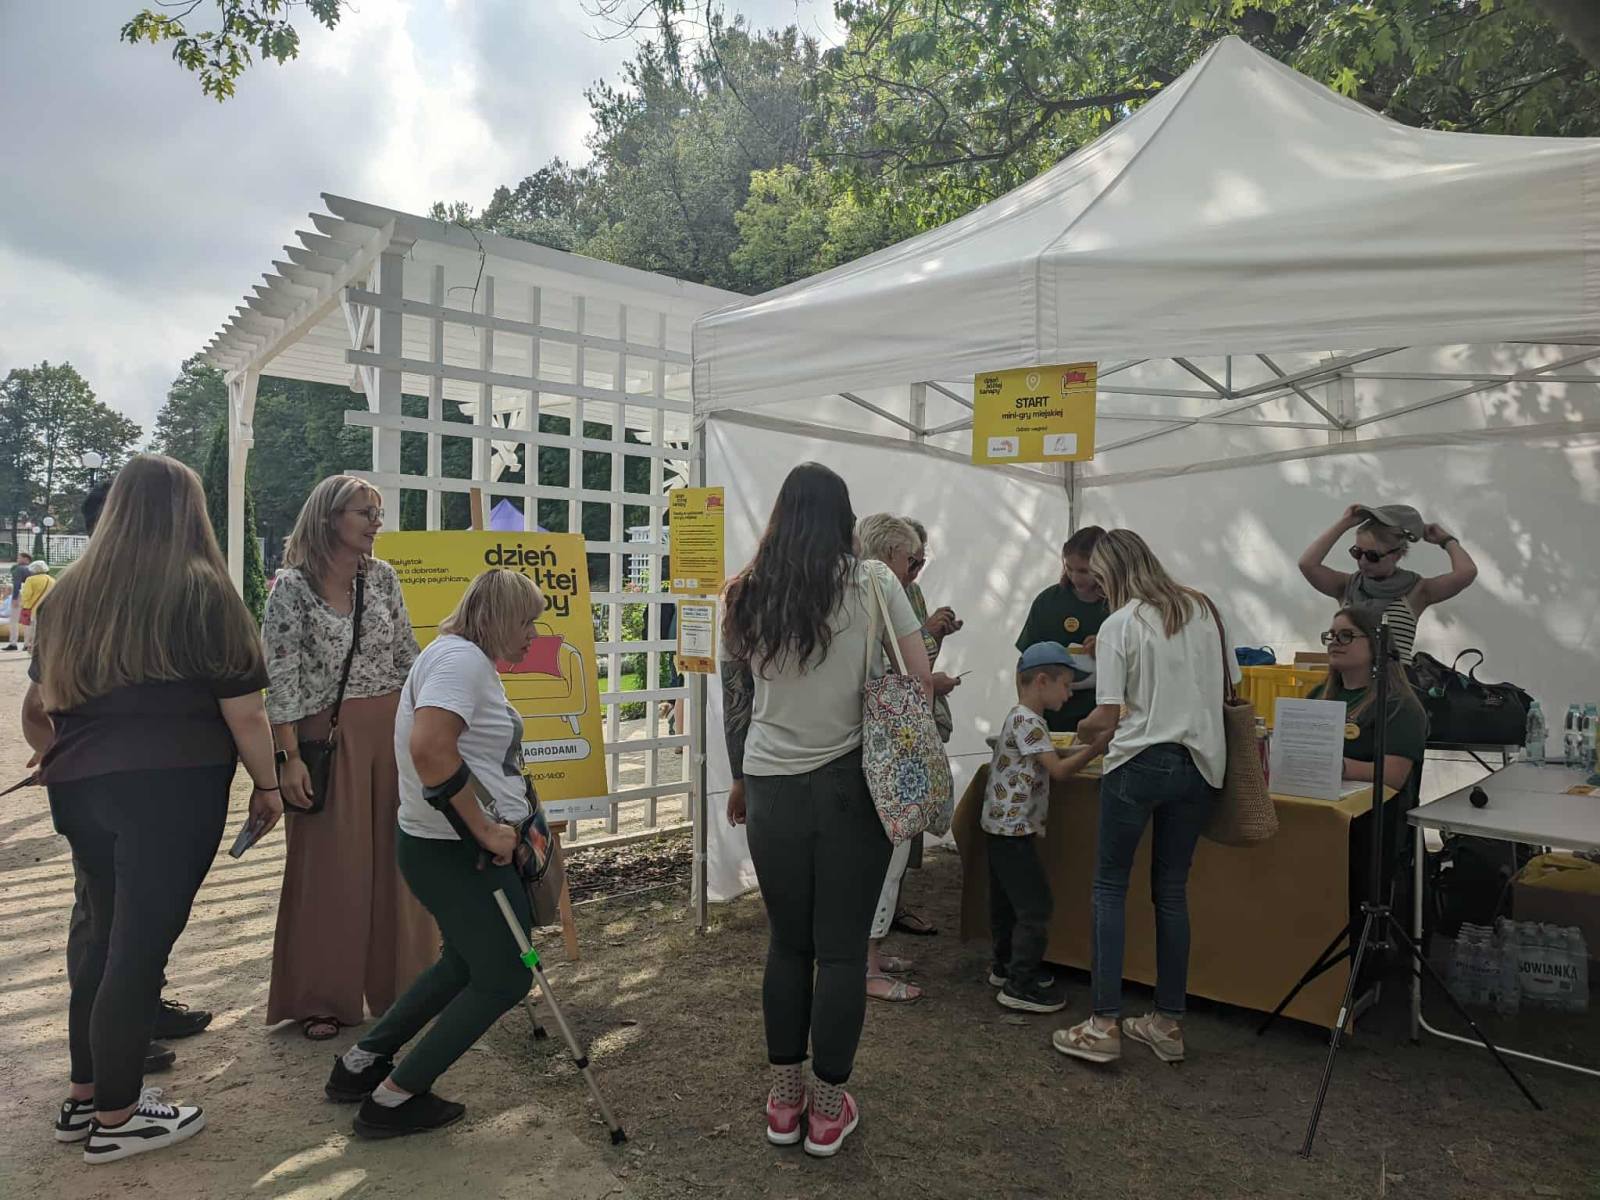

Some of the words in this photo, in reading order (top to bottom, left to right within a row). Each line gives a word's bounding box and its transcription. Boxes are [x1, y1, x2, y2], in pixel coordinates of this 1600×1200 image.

[1015, 396, 1050, 408] START
[1001, 412, 1031, 420] mini-gry
[1032, 409, 1064, 418] miejskiej
[484, 543, 557, 566] dzień
[399, 577, 426, 585] ndycję
[524, 745, 577, 757] AGRODAMI
[532, 772, 565, 780] :00-14:00
